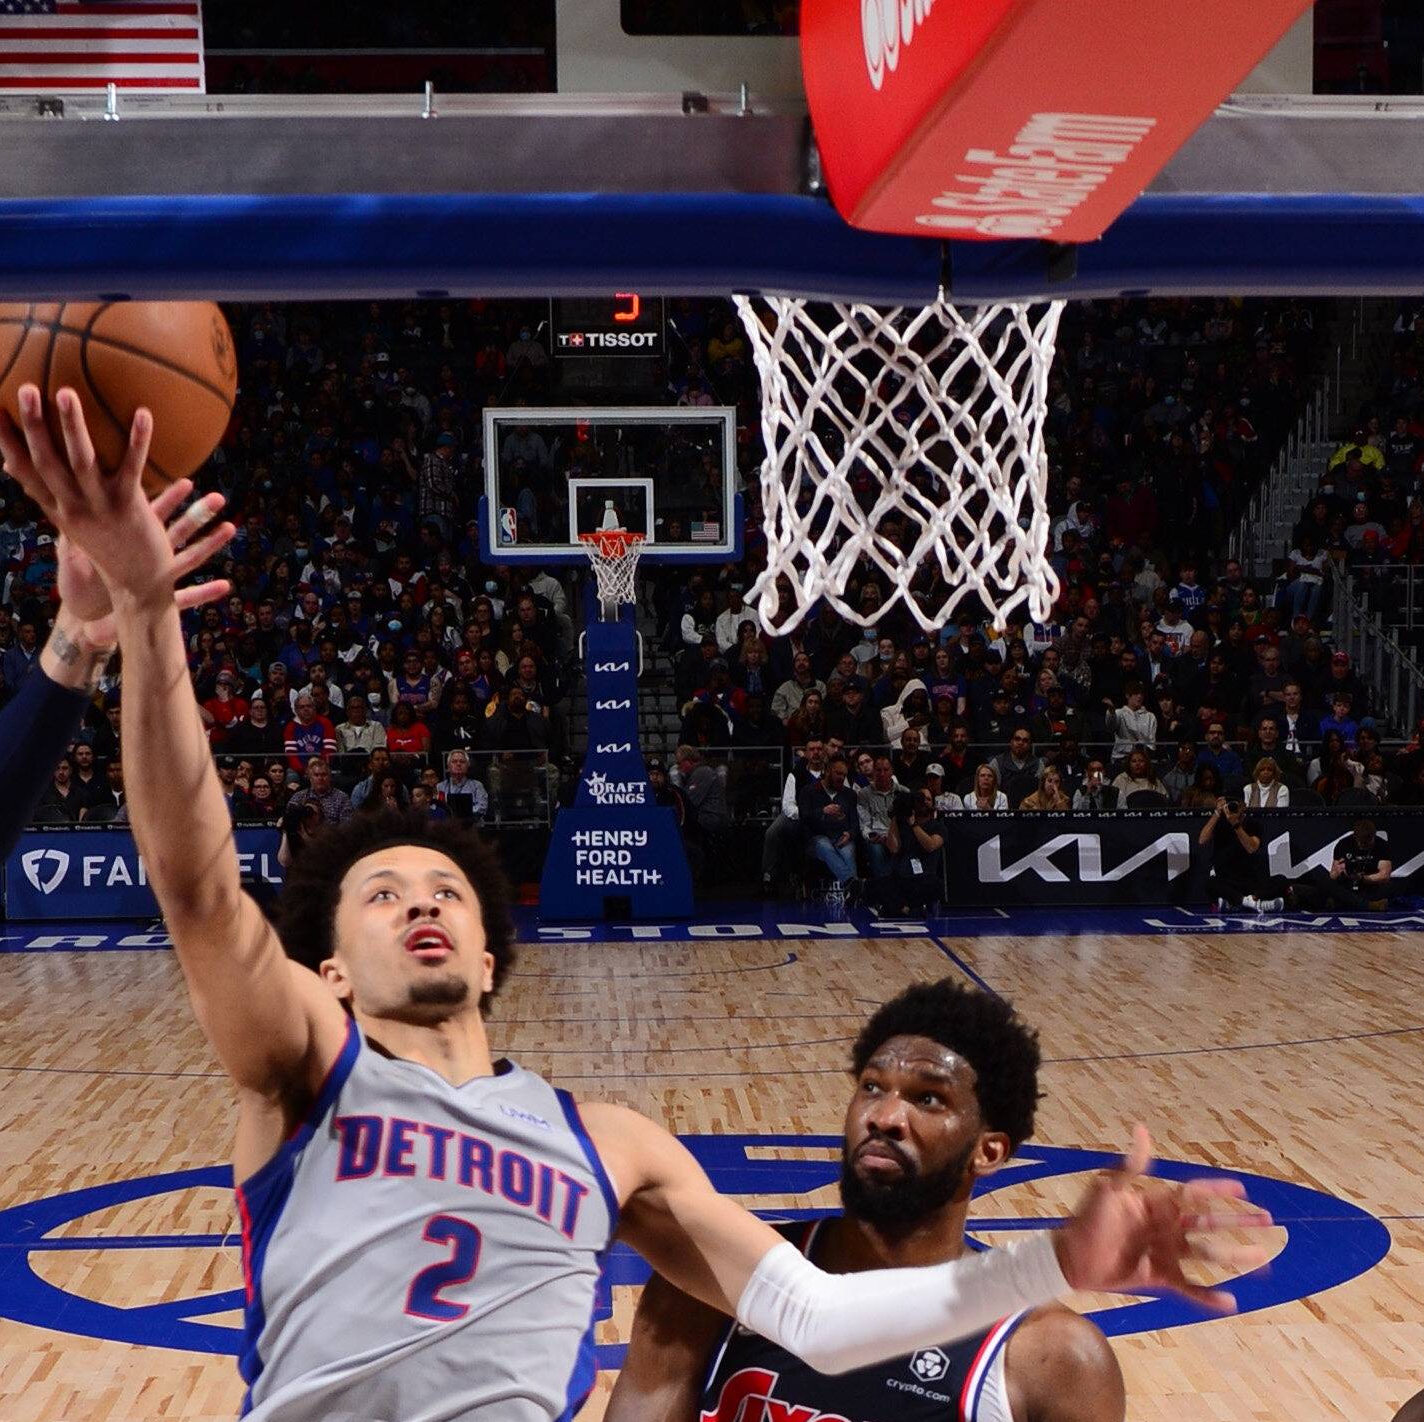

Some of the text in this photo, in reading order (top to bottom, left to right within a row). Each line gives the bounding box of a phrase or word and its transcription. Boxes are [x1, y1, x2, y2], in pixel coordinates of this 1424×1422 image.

[585, 332, 658, 347] TISSOT
[589, 781, 647, 796] DRAFT
[596, 793, 646, 804] KINGS
[572, 830, 648, 847] HENRY
[576, 850, 631, 866] FORD
[576, 869, 662, 886] HEALTH
[537, 921, 930, 940] STONS
[333, 1114, 591, 1240] DETROIT
[404, 1214, 482, 1322] 2
[886, 1377, 951, 1403] crypto.com
